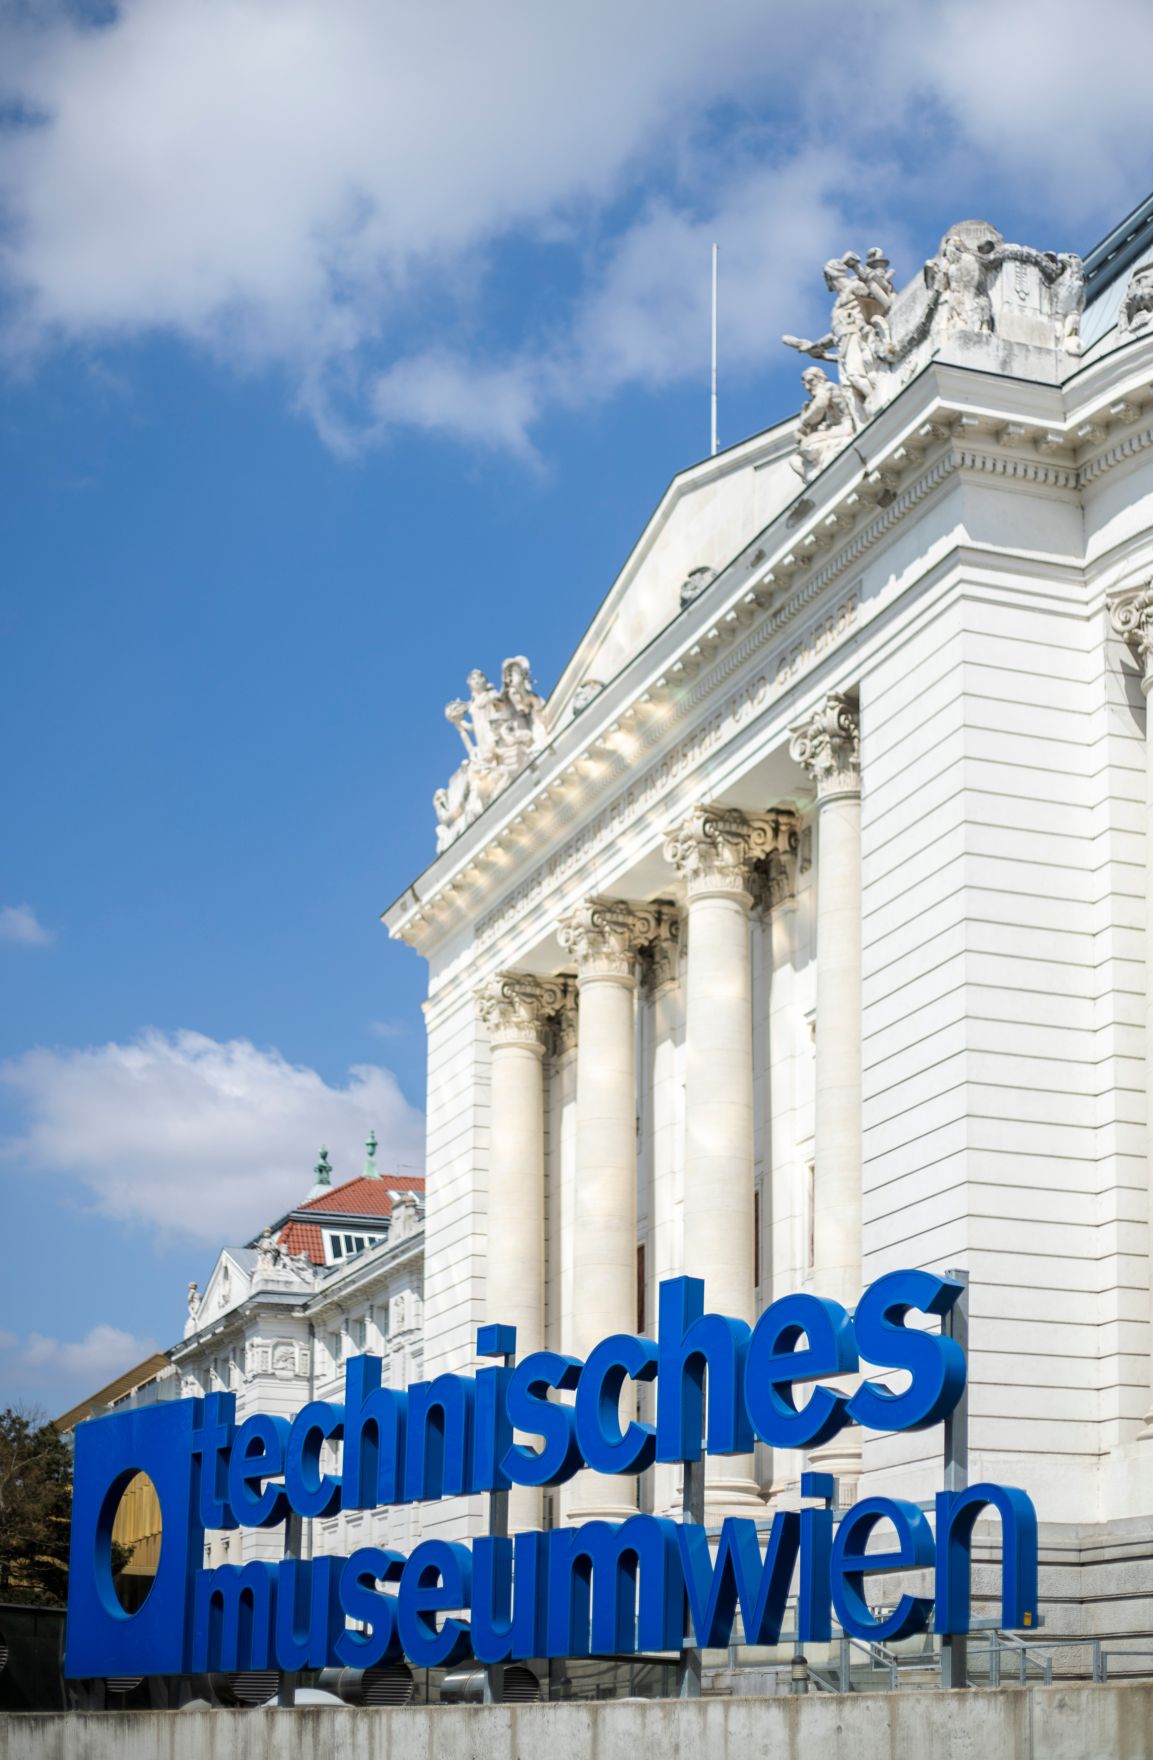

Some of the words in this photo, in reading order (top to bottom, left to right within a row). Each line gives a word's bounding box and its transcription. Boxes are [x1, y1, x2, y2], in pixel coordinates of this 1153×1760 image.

[644, 712, 721, 805] INDUSTRIE
[730, 672, 767, 728] UND
[776, 590, 858, 690] GEWERBE
[192, 1269, 966, 1530] technisches
